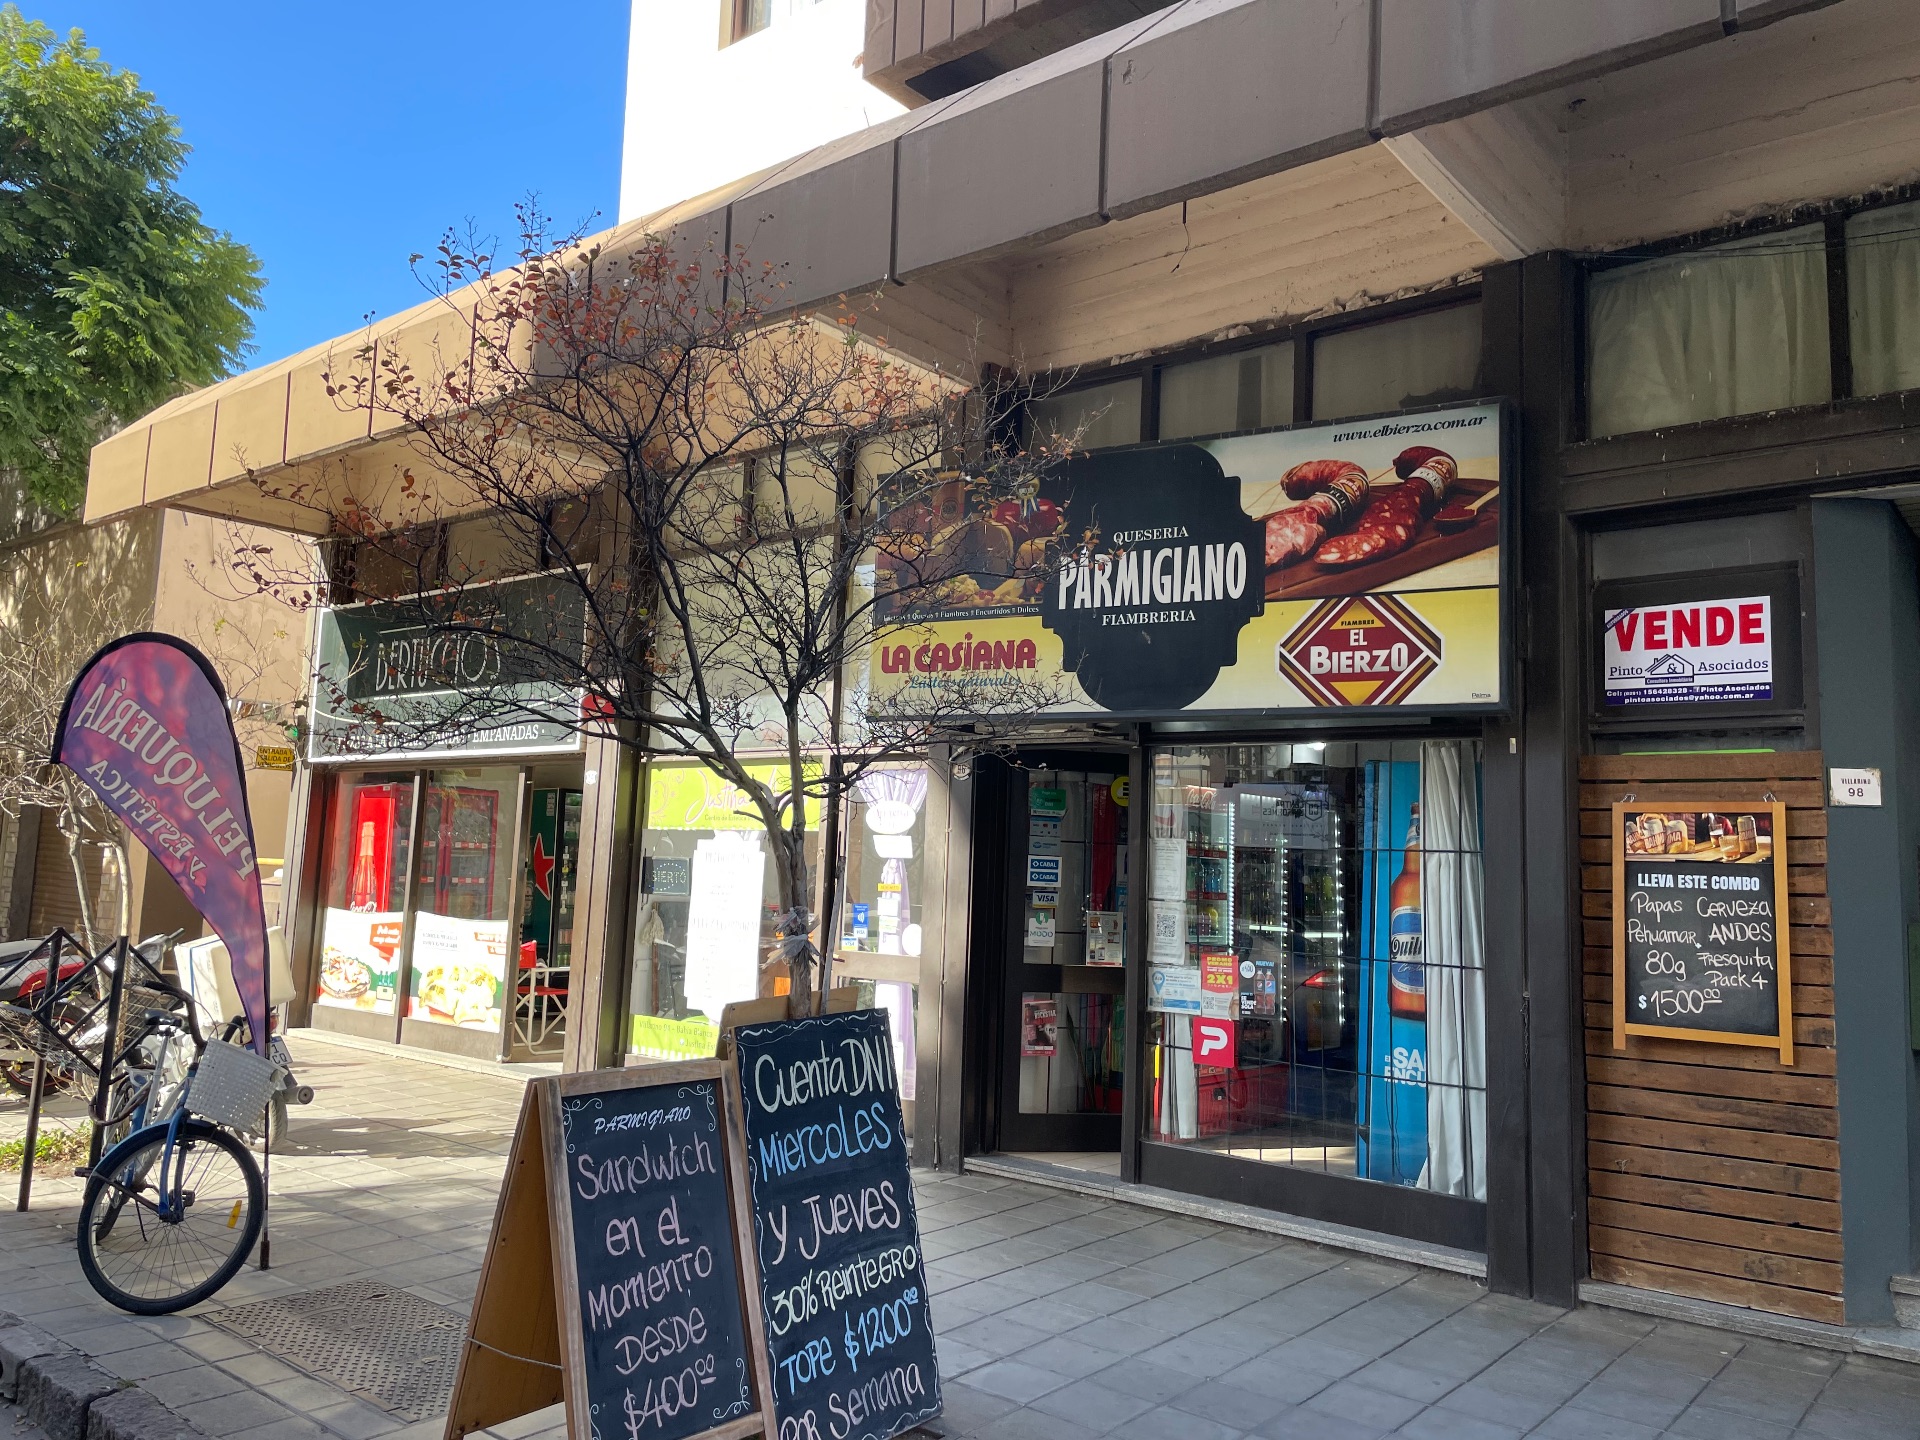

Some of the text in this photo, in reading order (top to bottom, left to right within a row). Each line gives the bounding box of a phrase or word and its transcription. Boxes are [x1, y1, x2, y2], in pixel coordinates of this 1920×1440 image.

[1332, 416, 1487, 443] www.elbierzo.com.ar
[1113, 525, 1189, 546] QUESERIA
[1058, 541, 1247, 610] PARMIGIANO
[940, 607, 969, 618] Fiambres
[975, 607, 1011, 617] Encurtidos
[1017, 605, 1040, 614] Dulces
[1101, 609, 1196, 626] FIAMBRERIA
[1340, 618, 1375, 627] FIAMBRES
[1349, 629, 1368, 646] EL
[1612, 603, 1765, 652] VENDE
[881, 631, 1037, 674] LA CASIANA
[1309, 642, 1409, 675] BIERZO
[1609, 659, 1769, 677] Pinto & Asociados
[1725, 683, 1770, 692] Asociados
[472, 723, 539, 743] EMPANADAS
[1848, 787, 1864, 797] 98
[1637, 873, 1760, 891] LLEVA ESTE COMBO
[1037, 894, 1055, 903] VISA
[1630, 891, 1683, 922] Papas
[1645, 950, 1686, 982] 80g
[1704, 970, 1769, 990] Pack 4
[1393, 1046, 1427, 1072] SA
[754, 1035, 893, 1114] Cuenta DNI
[594, 1105, 692, 1135] PARMIGIANO
[577, 1131, 717, 1200] Sandwich
[605, 1195, 690, 1258] en el
[798, 1179, 901, 1260] Jueves
[771, 1268, 819, 1336] 30%
[828, 1363, 925, 1440] Semana
